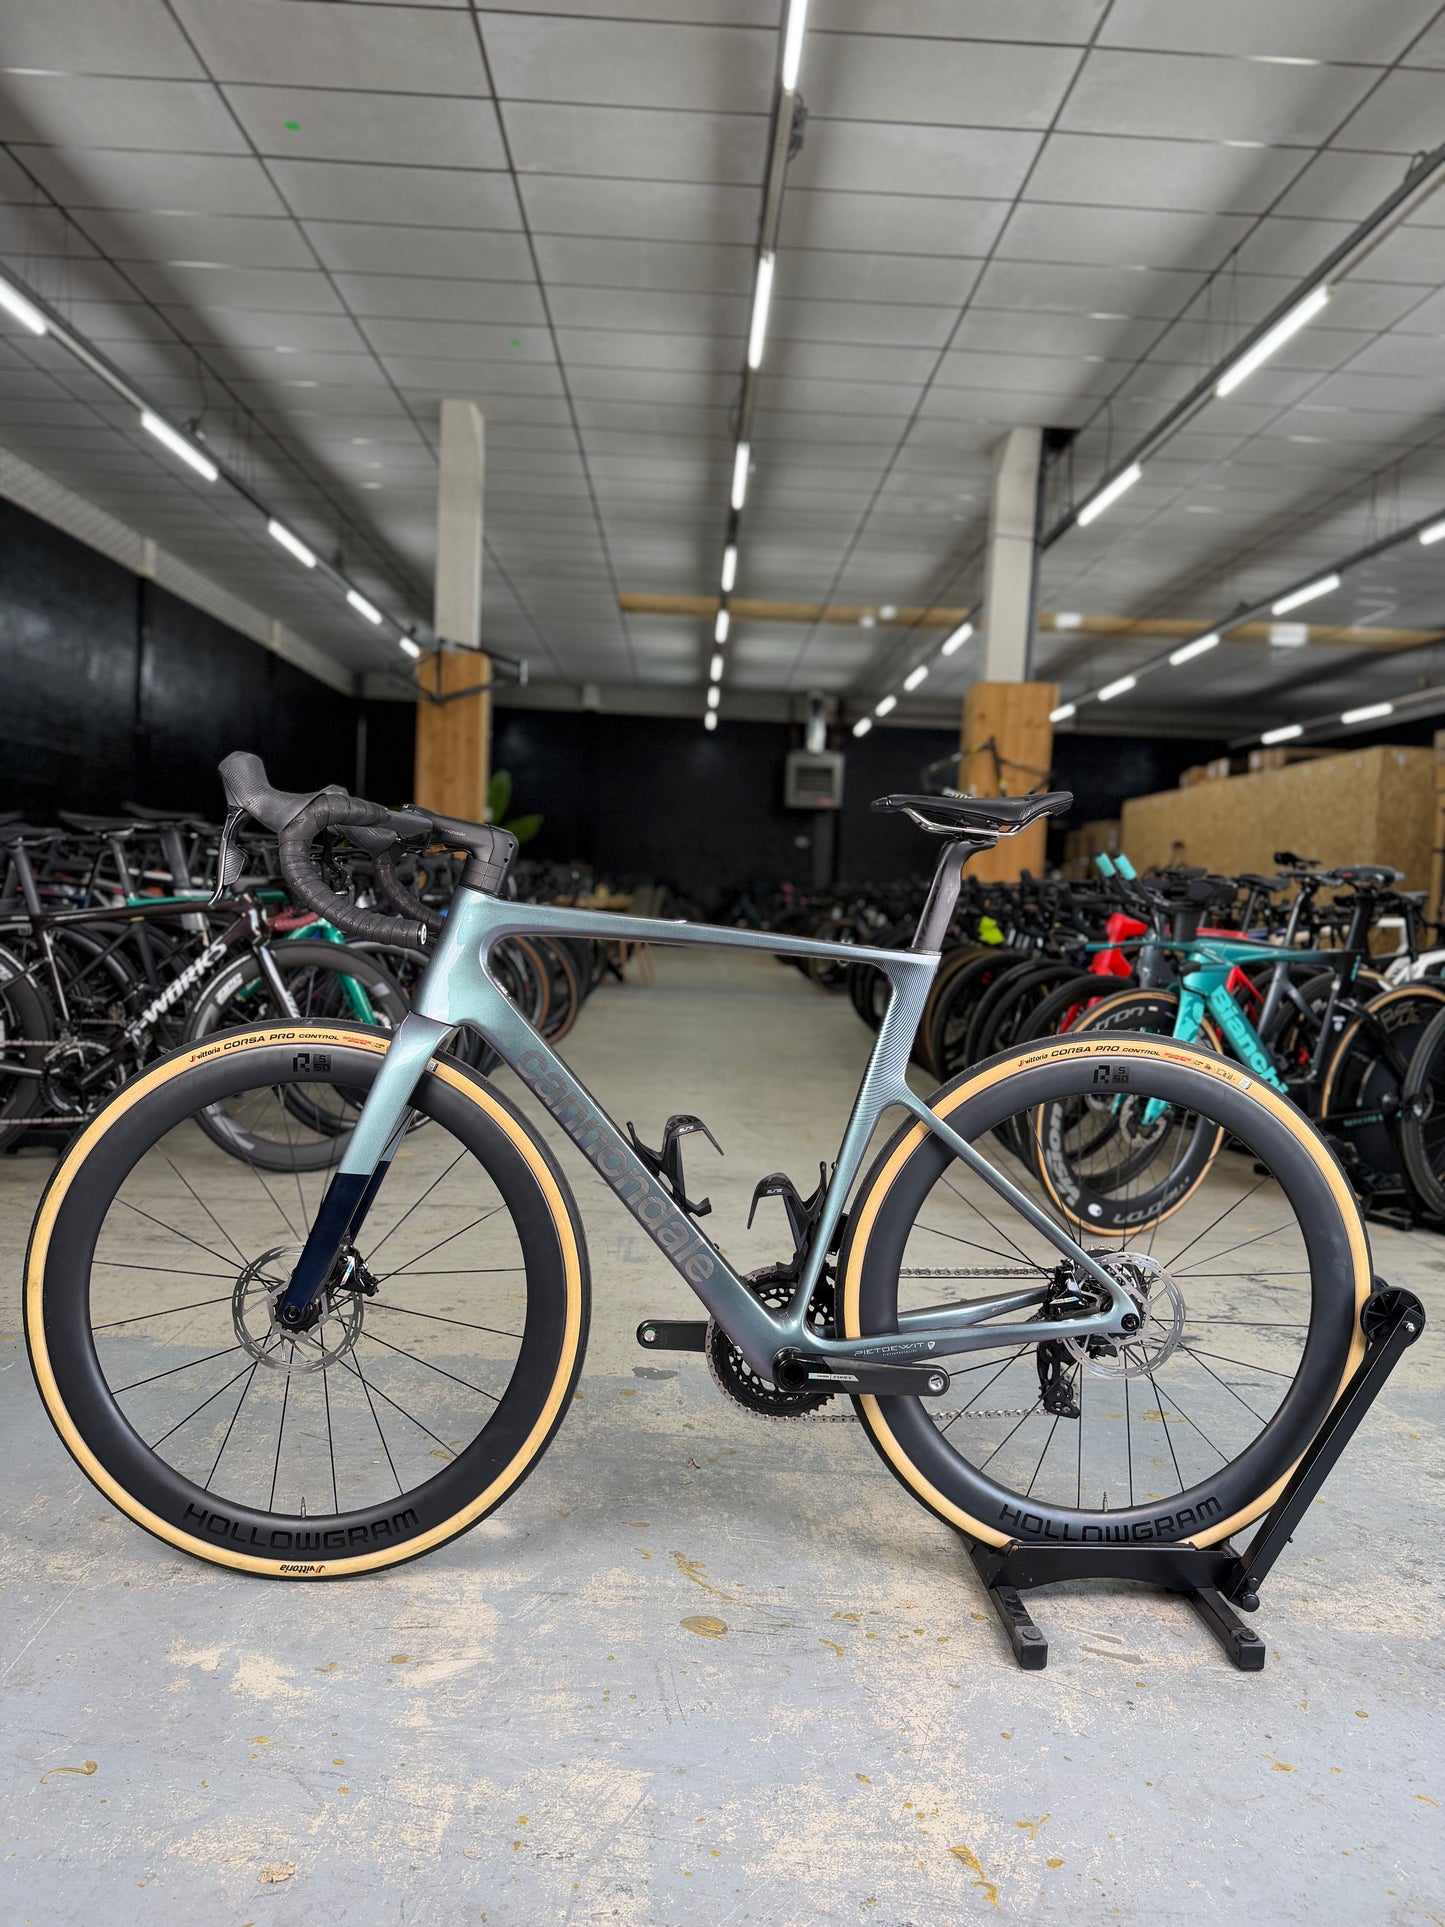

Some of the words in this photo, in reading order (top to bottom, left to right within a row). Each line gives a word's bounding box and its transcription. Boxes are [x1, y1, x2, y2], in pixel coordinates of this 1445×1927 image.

[196, 1046, 221, 1059] vittoria
[223, 1035, 265, 1051] CORSA
[269, 1032, 296, 1041] PRO
[299, 1033, 339, 1041] CONTROL
[1024, 1053, 1048, 1064] vittoria
[1051, 1046, 1091, 1057] CORSA
[1122, 1047, 1161, 1056] CONTROL
[516, 1050, 714, 1282] cannondale
[182, 1502, 420, 1550] HOLLOWGRAM
[998, 1496, 1223, 1542] HOLLOWGRAM
[280, 1564, 316, 1573] vittoria
